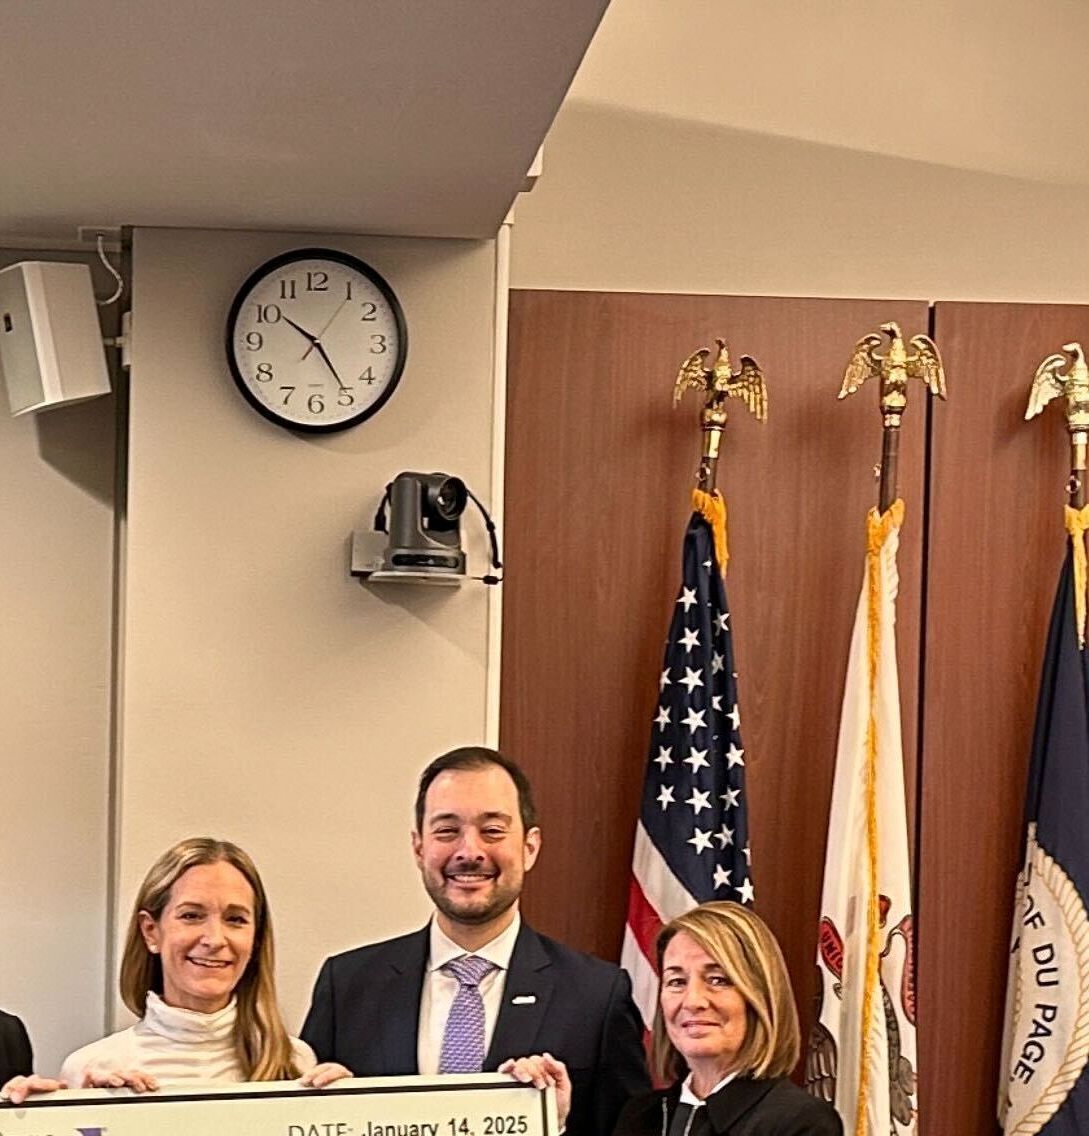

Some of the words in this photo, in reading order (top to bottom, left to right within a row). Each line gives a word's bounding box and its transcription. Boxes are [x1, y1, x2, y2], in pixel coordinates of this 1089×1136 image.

[280, 279, 297, 300] 11
[306, 271, 329, 292] 12
[346, 281, 352, 301] 1
[257, 303, 282, 324] 10
[361, 302, 378, 322] 2
[246, 331, 263, 351] 9
[370, 334, 387, 354] 3
[256, 363, 274, 383] 8
[358, 366, 375, 385] 4
[279, 386, 296, 405] 7
[307, 393, 325, 414] 6
[337, 386, 355, 407] 5
[1032, 942, 1060, 988] DU
[448, 1117, 476, 1136] 14,
[483, 1115, 528, 1135] 2025
